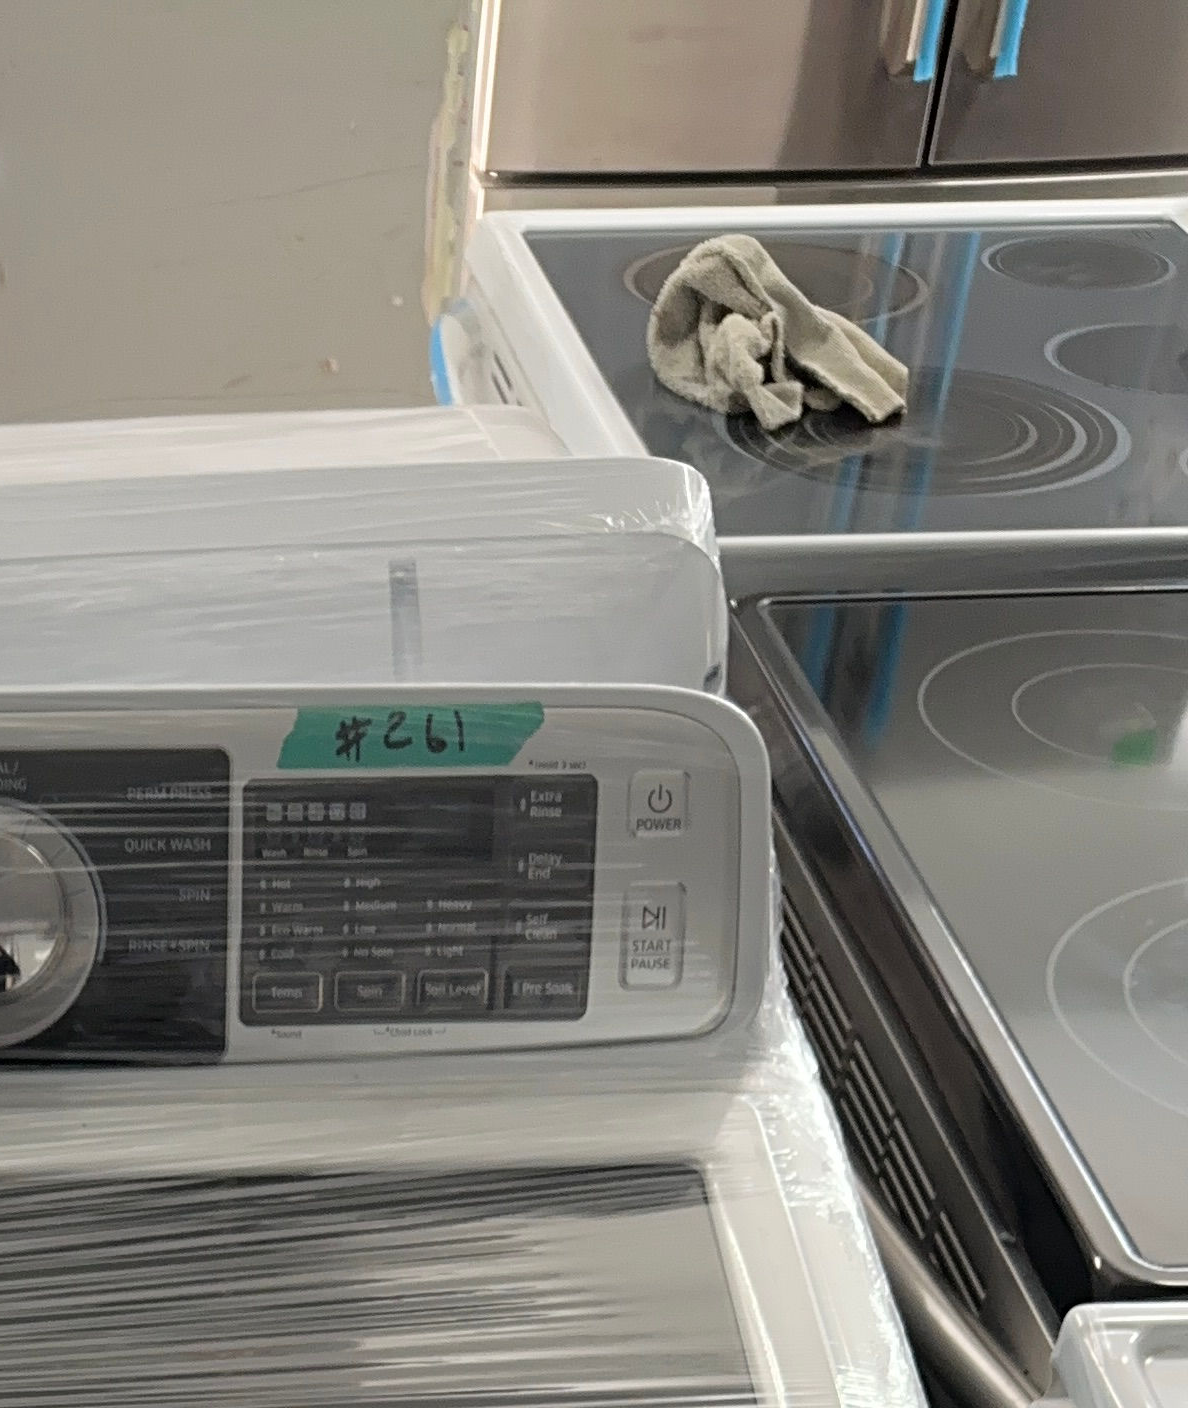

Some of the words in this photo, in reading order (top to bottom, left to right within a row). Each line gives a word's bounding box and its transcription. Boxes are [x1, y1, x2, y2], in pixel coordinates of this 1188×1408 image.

[530, 790, 562, 802] Extra
[530, 806, 562, 818] Rinse
[636, 818, 682, 831] POWER
[124, 838, 166, 853] QUICK
[170, 838, 212, 851] WASH
[528, 853, 562, 868] Delay
[528, 867, 551, 880] End
[632, 940, 672, 952] START
[631, 958, 670, 970] PAUSE
